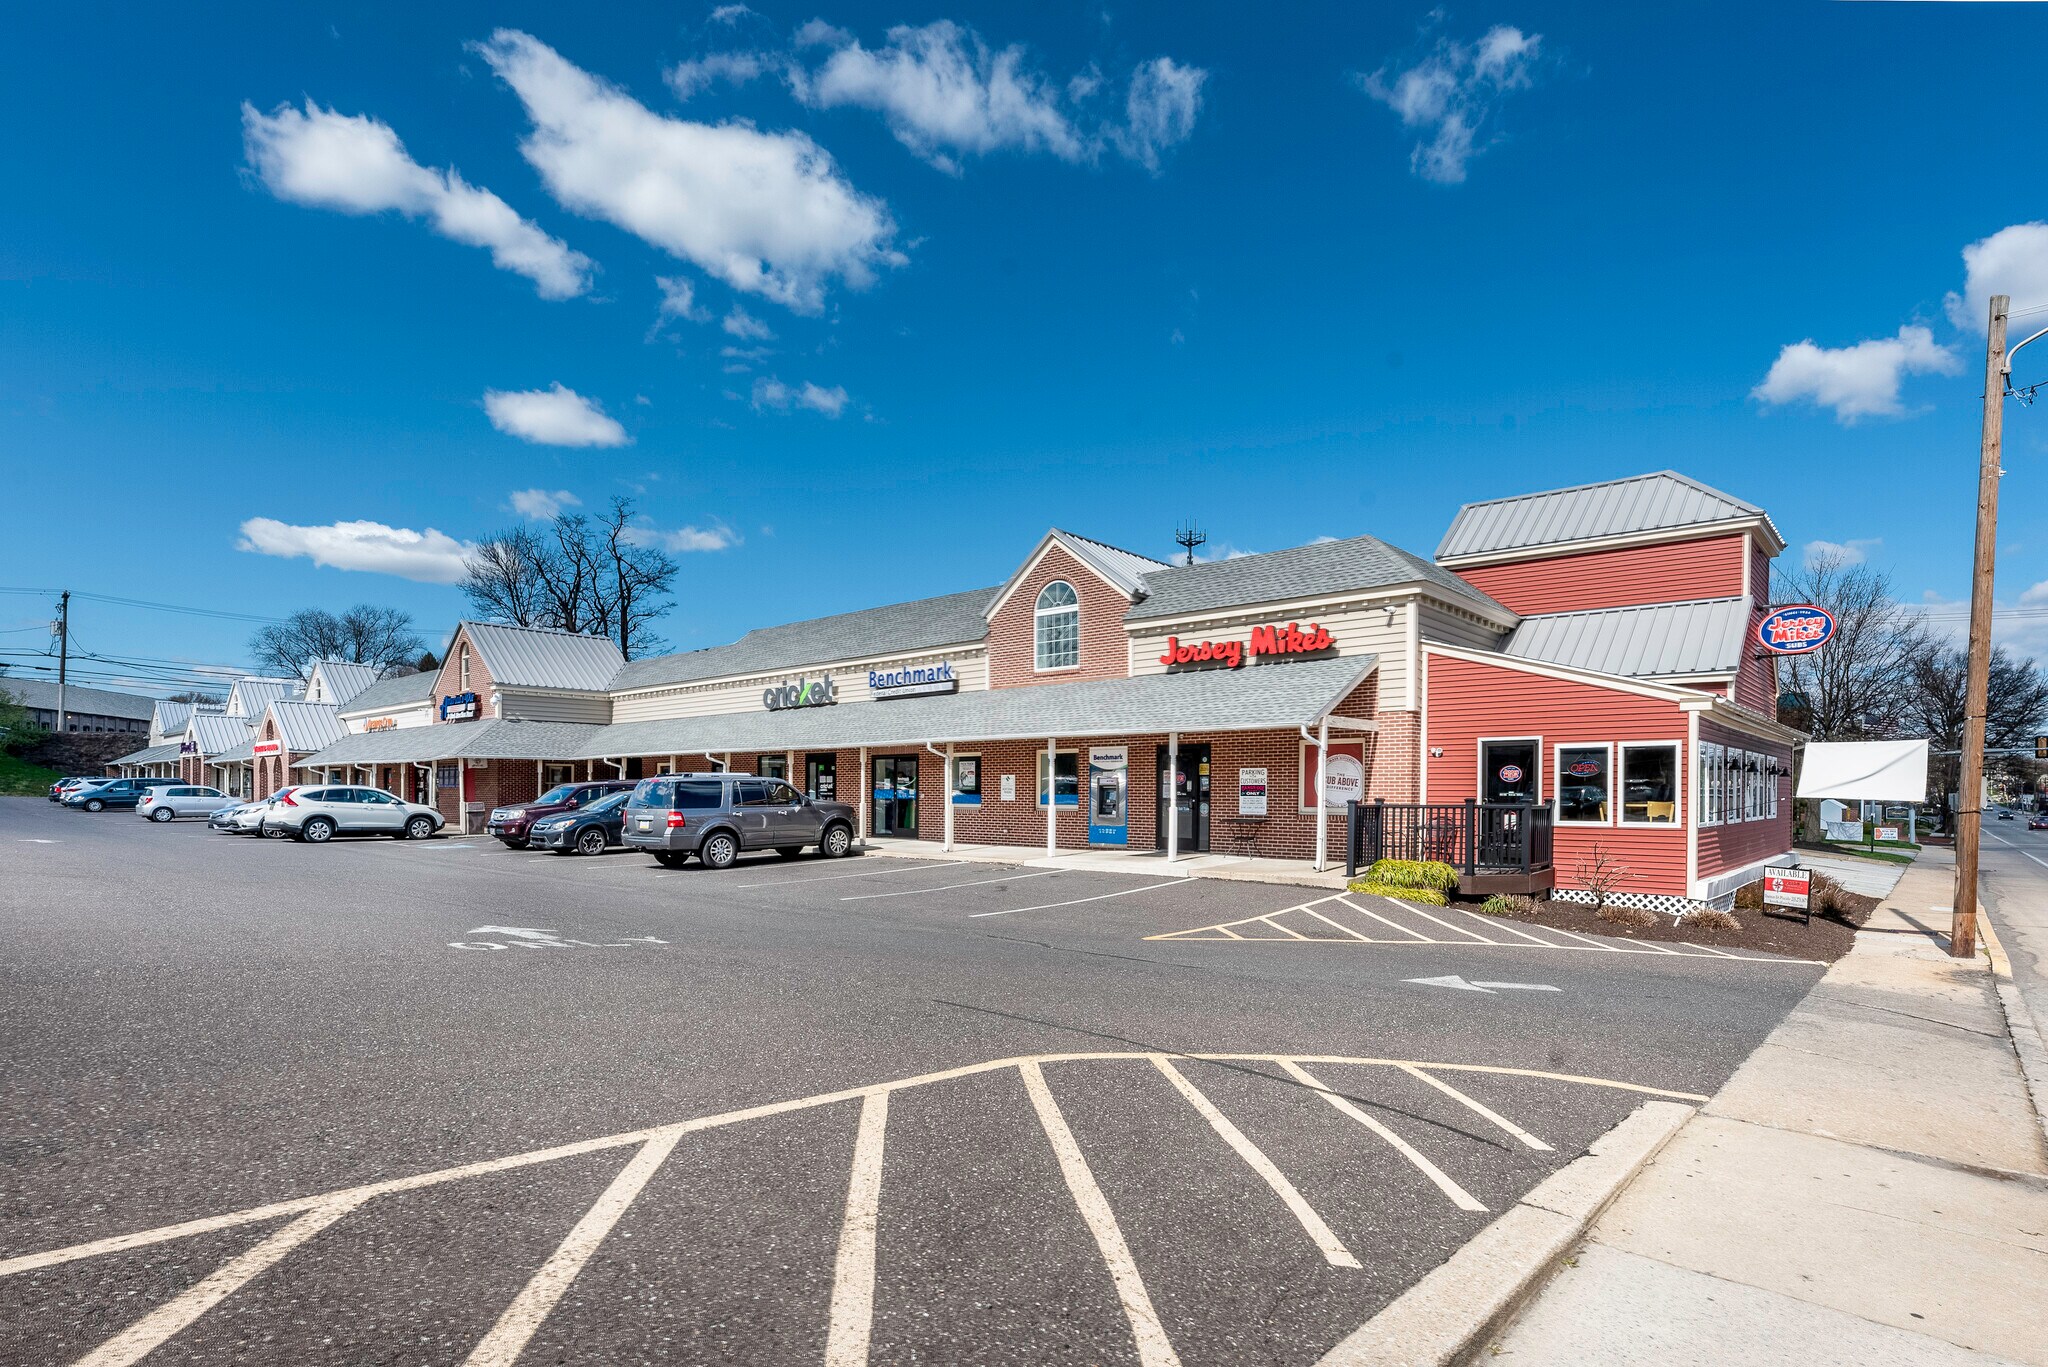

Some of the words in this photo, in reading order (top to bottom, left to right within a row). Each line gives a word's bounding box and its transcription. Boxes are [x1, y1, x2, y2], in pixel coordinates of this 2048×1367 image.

[1768, 616, 1826, 631] Jersey
[1771, 628, 1825, 643] Mike's
[1160, 636, 1242, 667] Jersey
[1249, 622, 1336, 656] Mike's
[1785, 641, 1808, 649] SUBS
[869, 660, 952, 688] Benchmark
[763, 674, 833, 709] cricket
[1570, 763, 1599, 773] OPEN
[1326, 776, 1336, 785] UB
[1337, 777, 1359, 787] ABOVE
[1769, 869, 1807, 879] AVAILABLE
